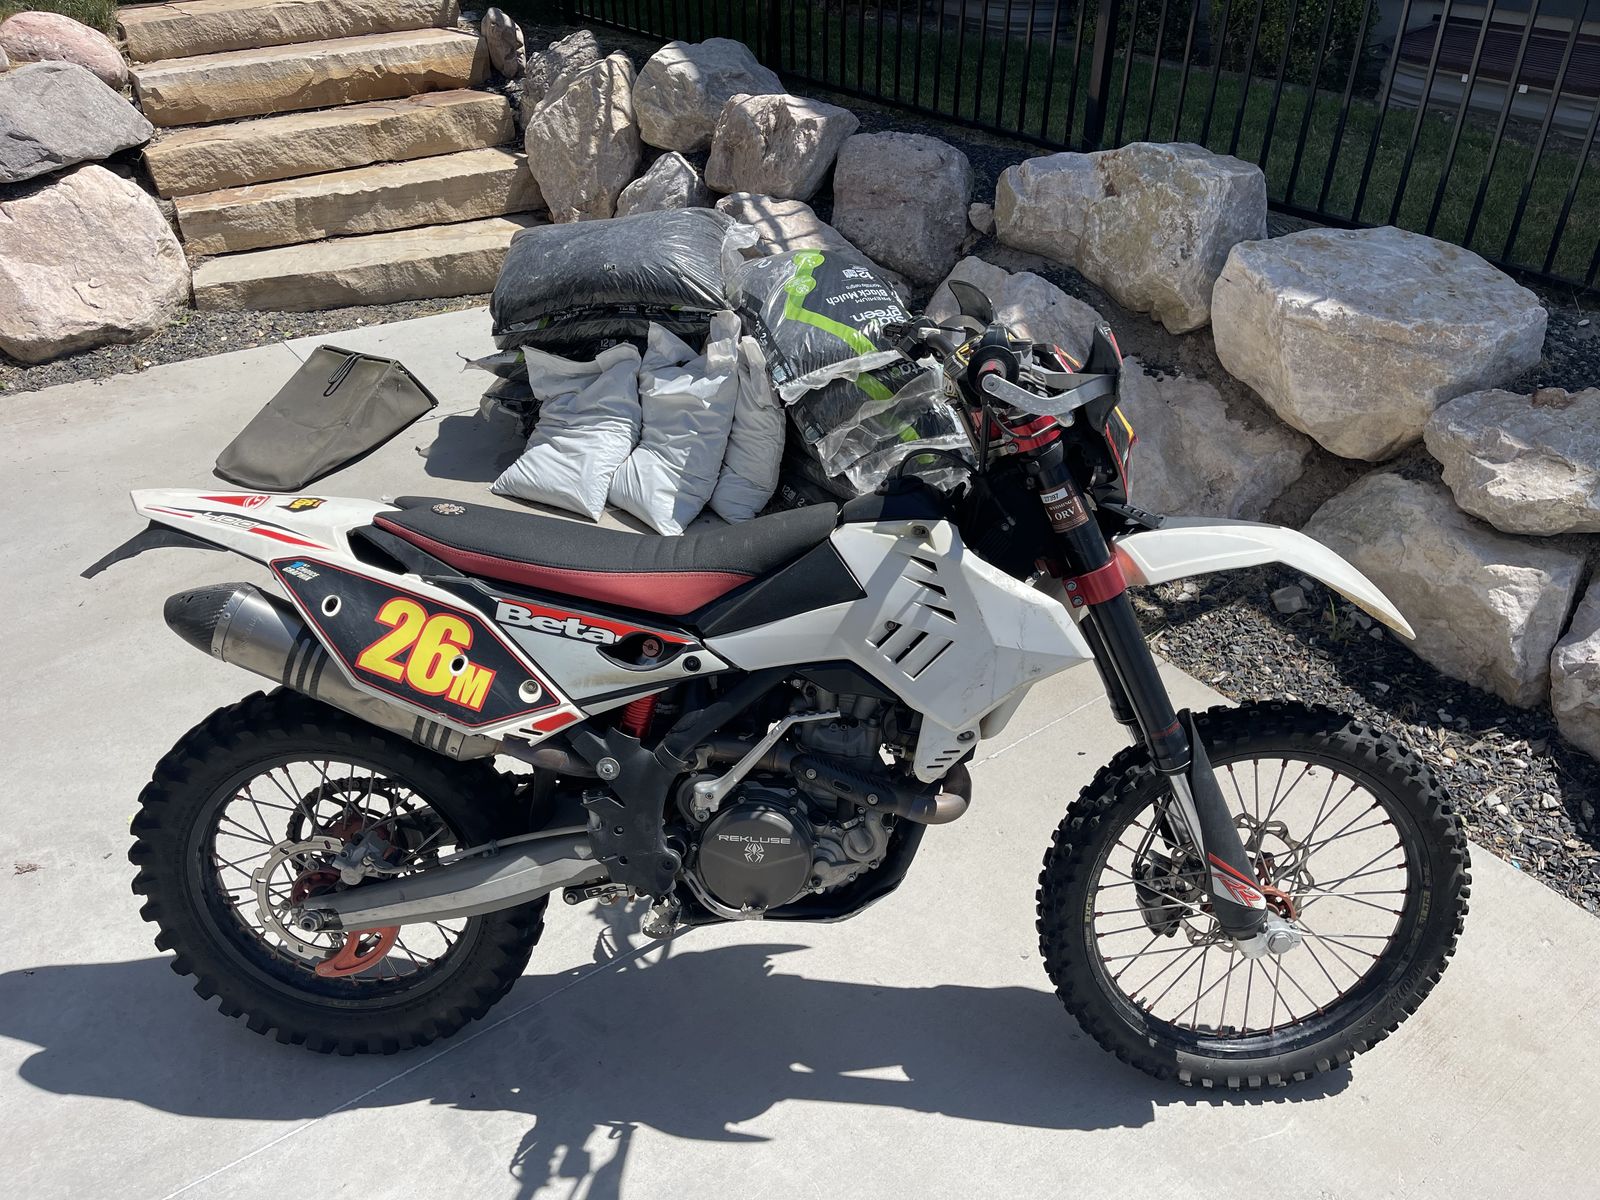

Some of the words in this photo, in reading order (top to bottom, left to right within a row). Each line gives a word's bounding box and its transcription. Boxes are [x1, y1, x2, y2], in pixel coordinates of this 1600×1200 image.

[856, 269, 874, 281] 12
[825, 291, 858, 306] Mulch
[854, 296, 892, 304] PREMIUM
[857, 288, 888, 299] Black
[1054, 506, 1075, 521] ORV
[494, 602, 620, 646] Beta
[717, 832, 792, 846] REKLUSE
